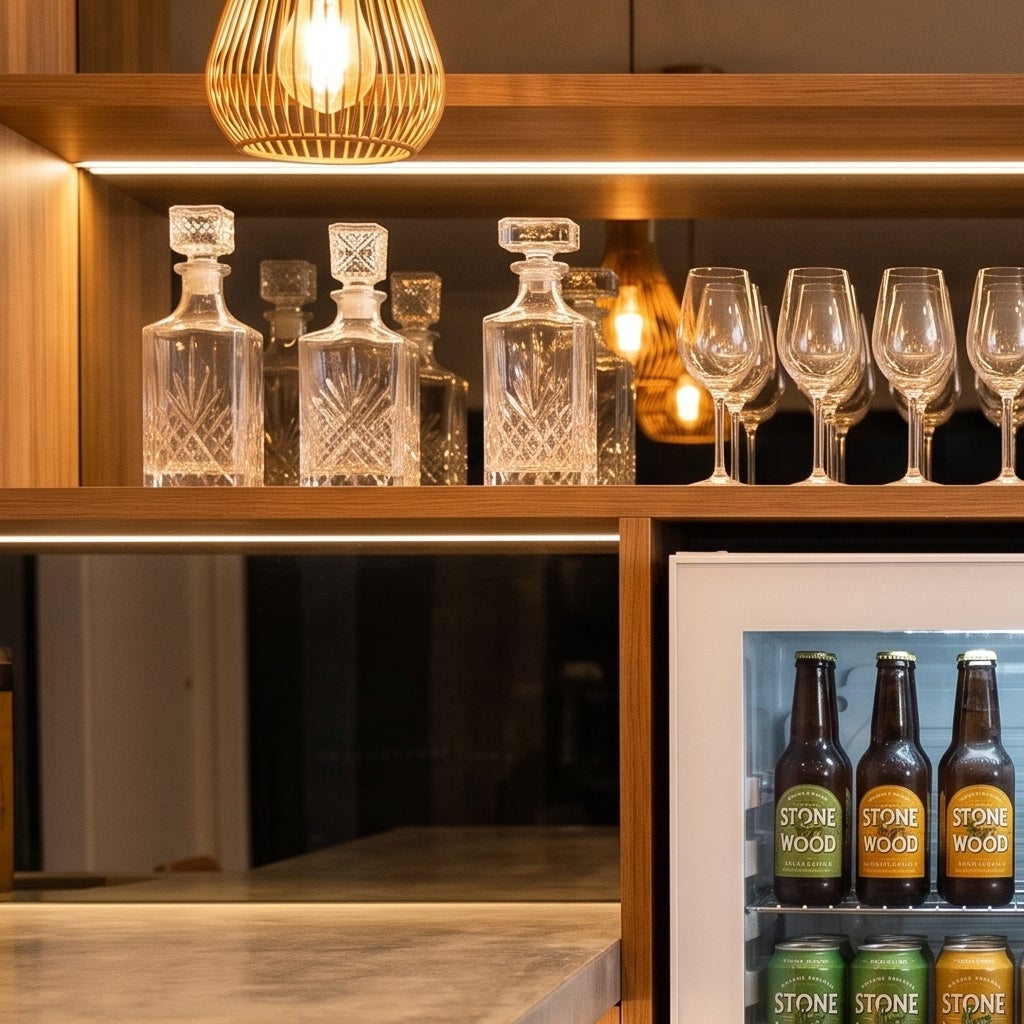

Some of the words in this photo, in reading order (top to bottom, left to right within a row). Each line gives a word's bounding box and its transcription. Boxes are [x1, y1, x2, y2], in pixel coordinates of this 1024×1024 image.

[780, 807, 836, 828] STONE
[863, 807, 918, 828] STONE
[952, 807, 1008, 827] STONE
[780, 833, 836, 853] WOOD
[864, 834, 919, 853] WOOD
[953, 833, 1008, 853] WOOD
[774, 992, 838, 1015] STONE
[855, 992, 919, 1015] STONE
[942, 992, 1005, 1015] STONE
